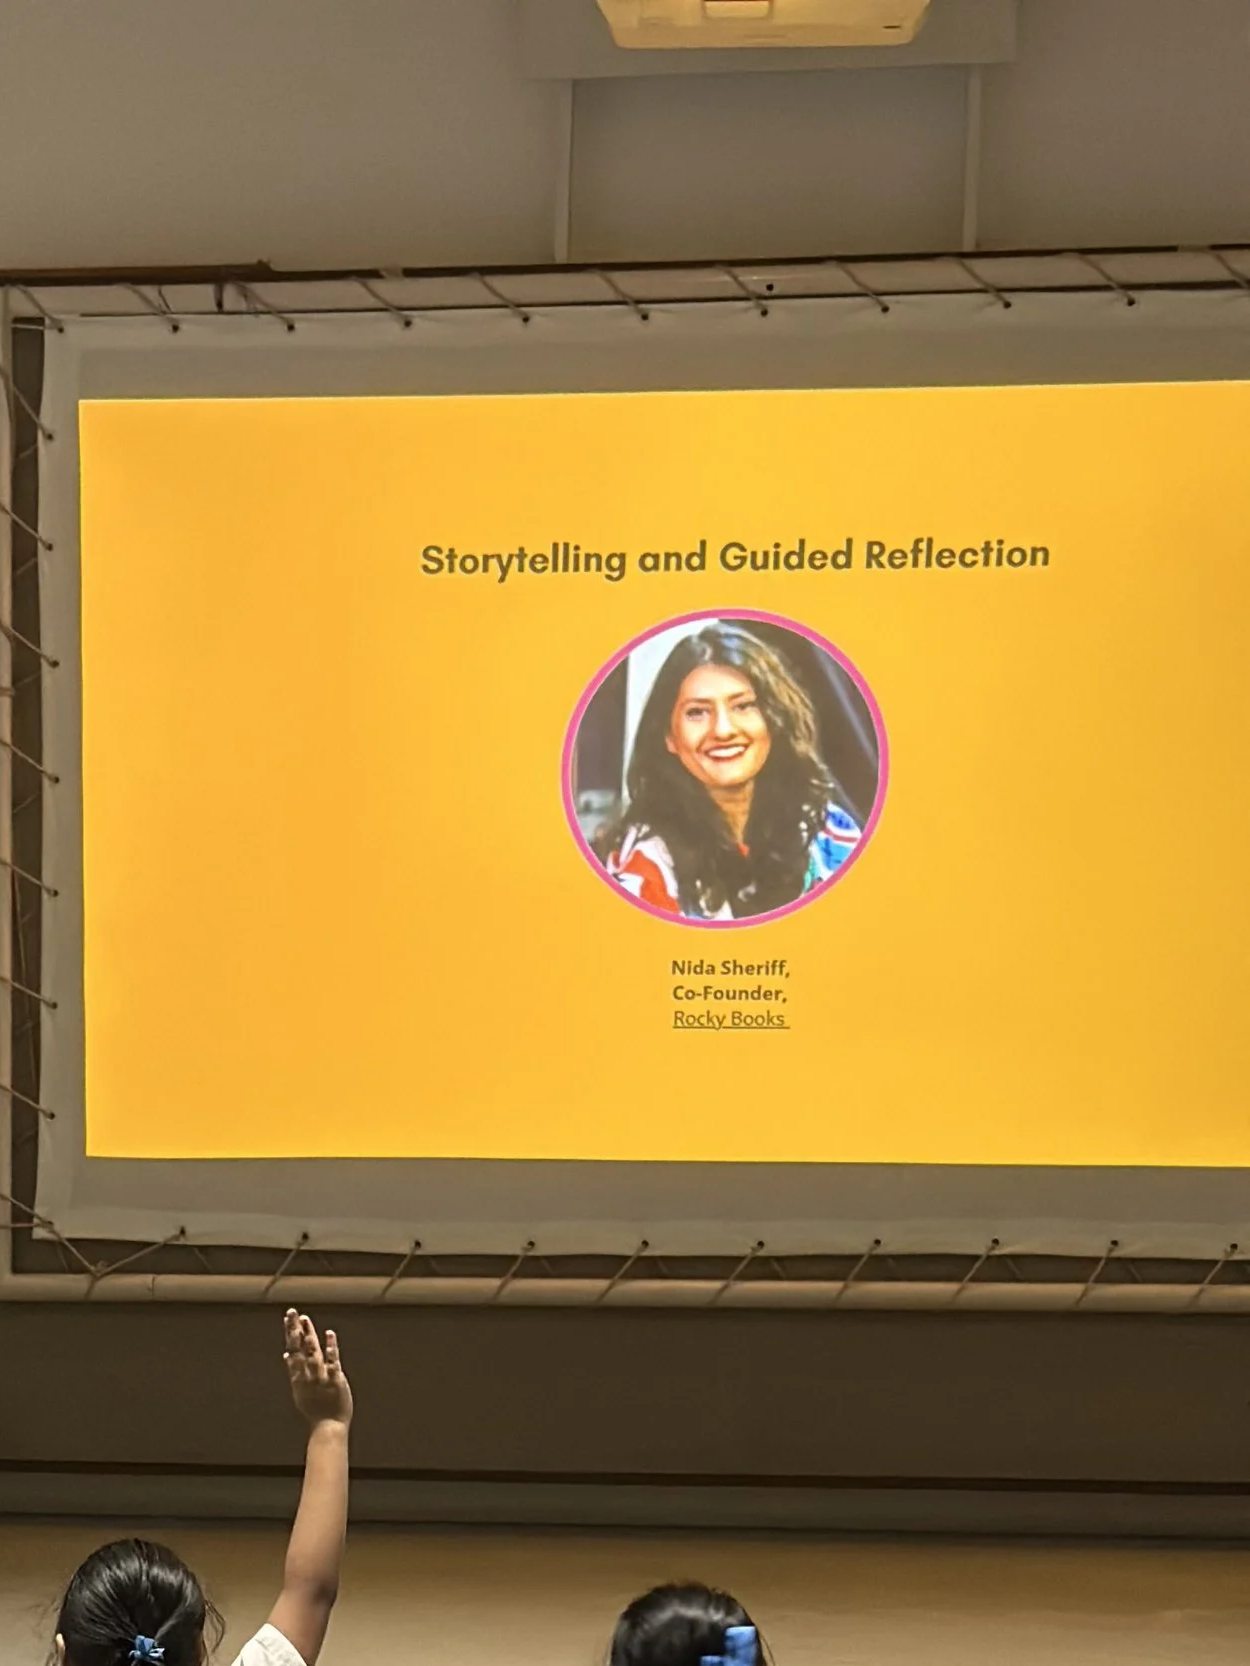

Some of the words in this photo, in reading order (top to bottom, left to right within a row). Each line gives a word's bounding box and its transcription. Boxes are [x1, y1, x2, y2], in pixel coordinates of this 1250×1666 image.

[421, 542, 627, 583] Storytelling
[639, 539, 707, 572] and
[719, 539, 853, 572] Guided
[865, 537, 1051, 571] Reflection
[672, 960, 716, 976] Nida
[721, 959, 790, 979] Sheriff,
[672, 985, 788, 1004] Co-Founder,
[673, 1010, 726, 1031] Rocky
[731, 1010, 786, 1028] Books
